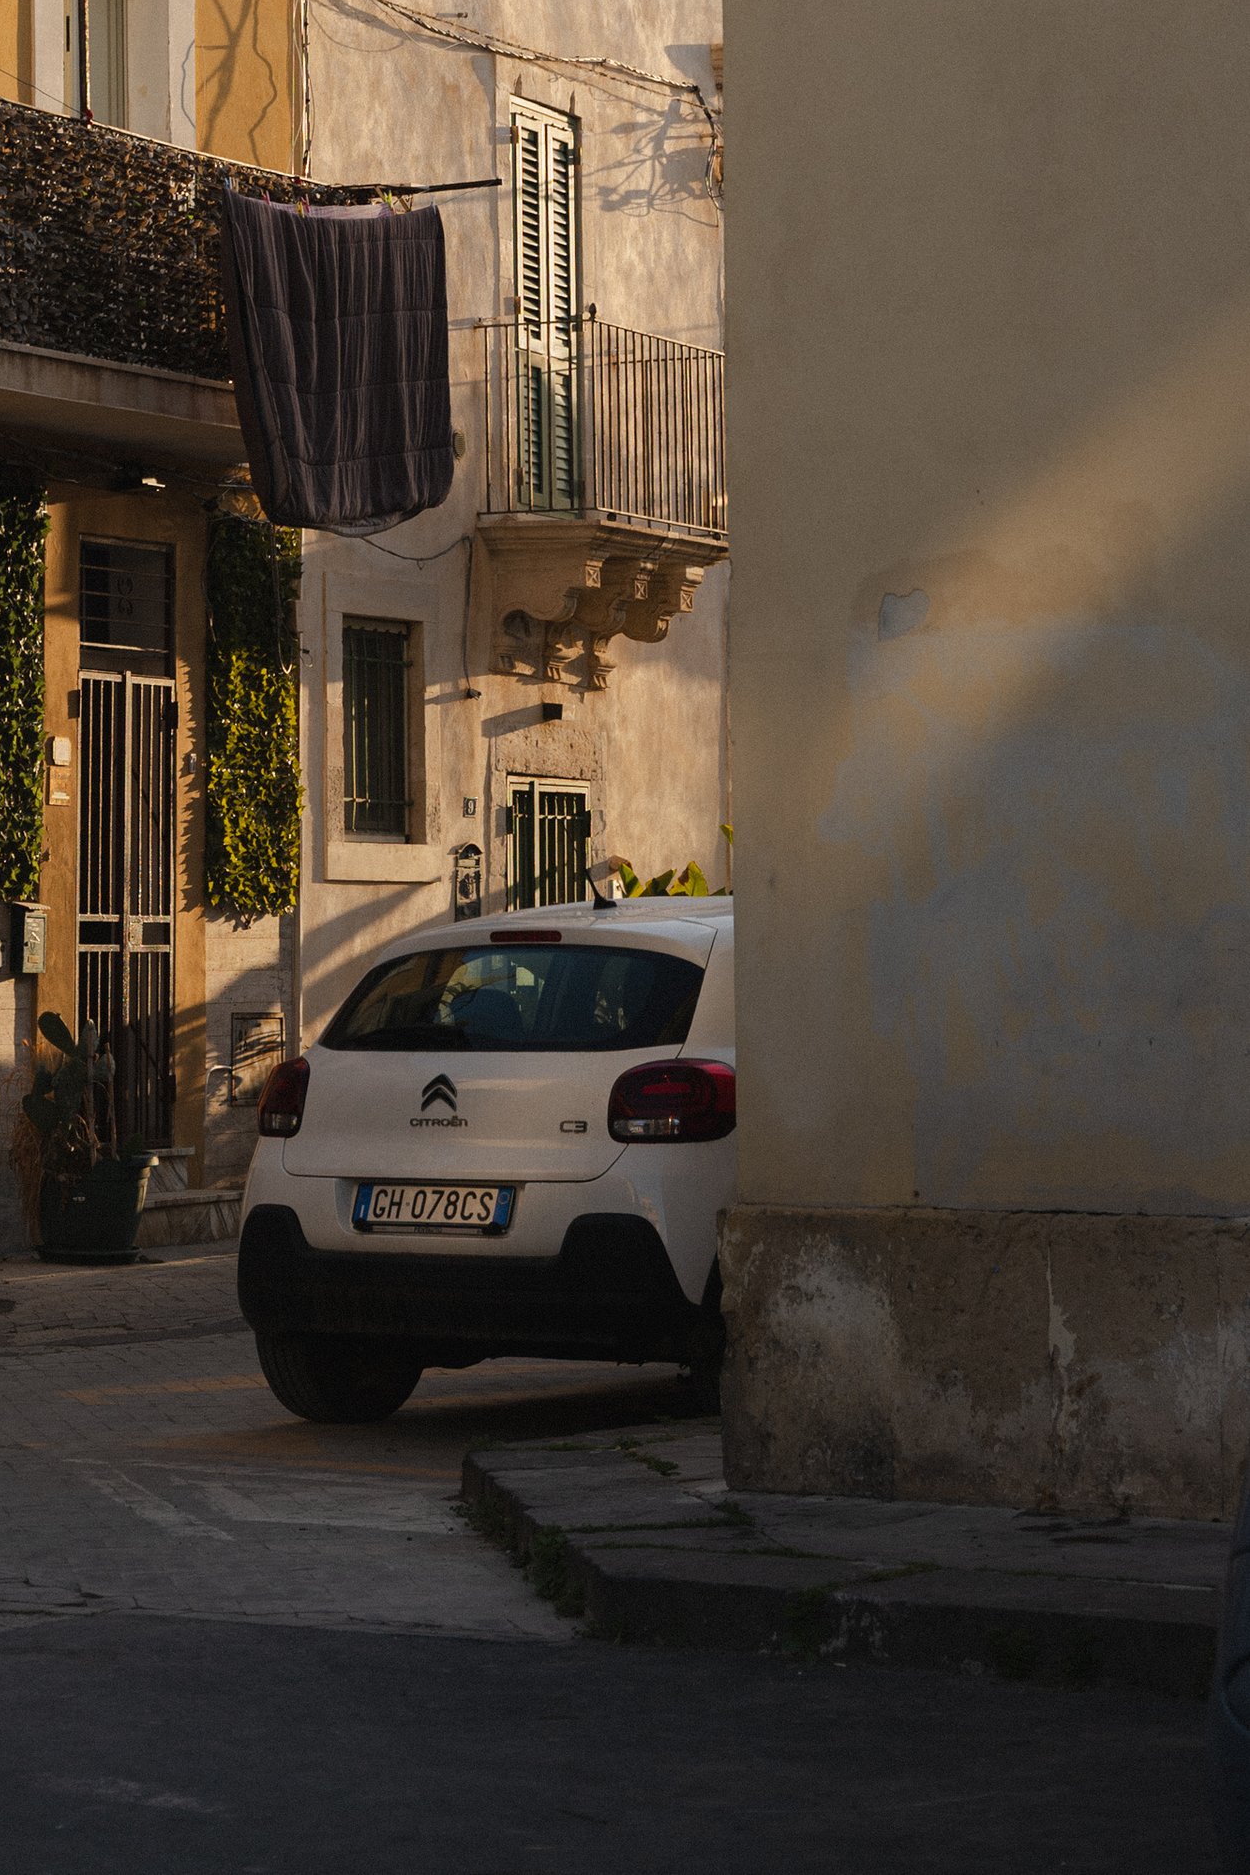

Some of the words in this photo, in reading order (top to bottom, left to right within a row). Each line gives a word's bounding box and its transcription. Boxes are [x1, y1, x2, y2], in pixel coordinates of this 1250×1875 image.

[467, 800, 474, 815] 9
[410, 1115, 468, 1128] CITROËN
[559, 1120, 588, 1134] C3
